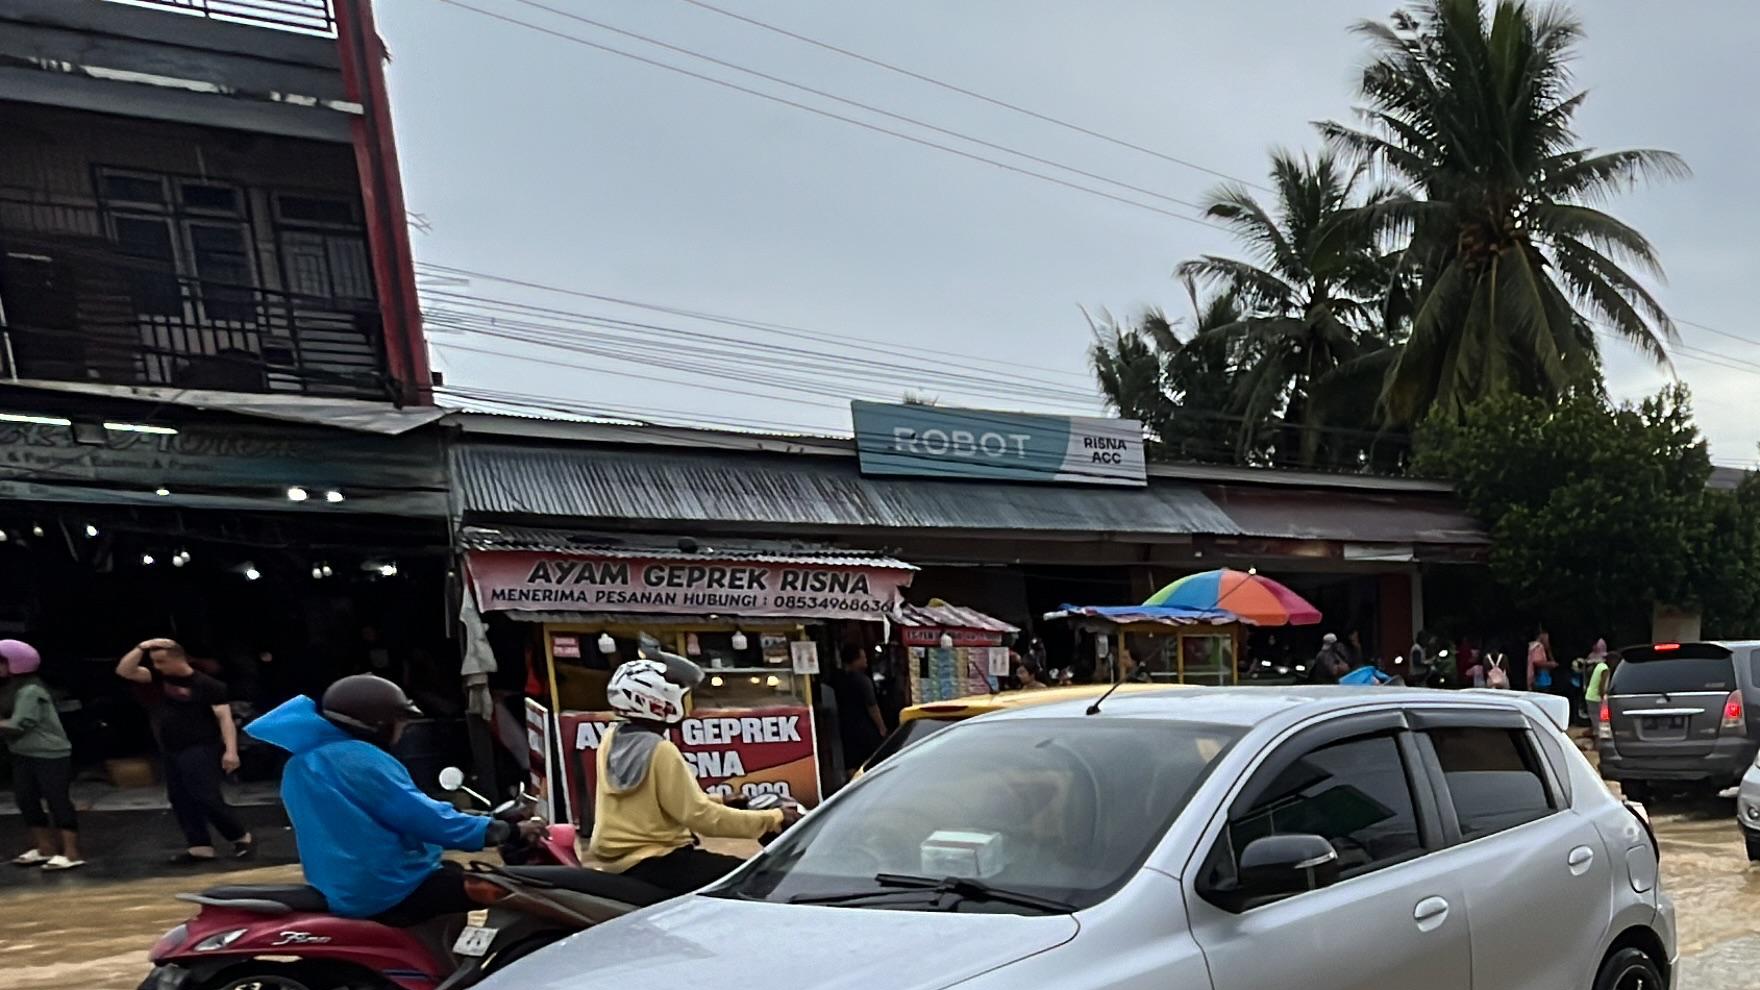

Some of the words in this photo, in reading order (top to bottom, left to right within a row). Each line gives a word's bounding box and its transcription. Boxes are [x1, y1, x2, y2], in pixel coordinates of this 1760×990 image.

[893, 427, 1031, 459] ROBOT
[1083, 437, 1127, 450] RISNA
[1091, 451, 1121, 464] ACC
[527, 560, 629, 586] AYAM
[643, 564, 769, 591] GEPREK
[780, 569, 869, 595] RISNA
[491, 588, 588, 603] MENERIMA
[595, 590, 676, 605] PESANAN
[683, 593, 757, 607] HUBUNGI
[681, 716, 801, 746] GEPREK
[687, 751, 746, 779] SNA
